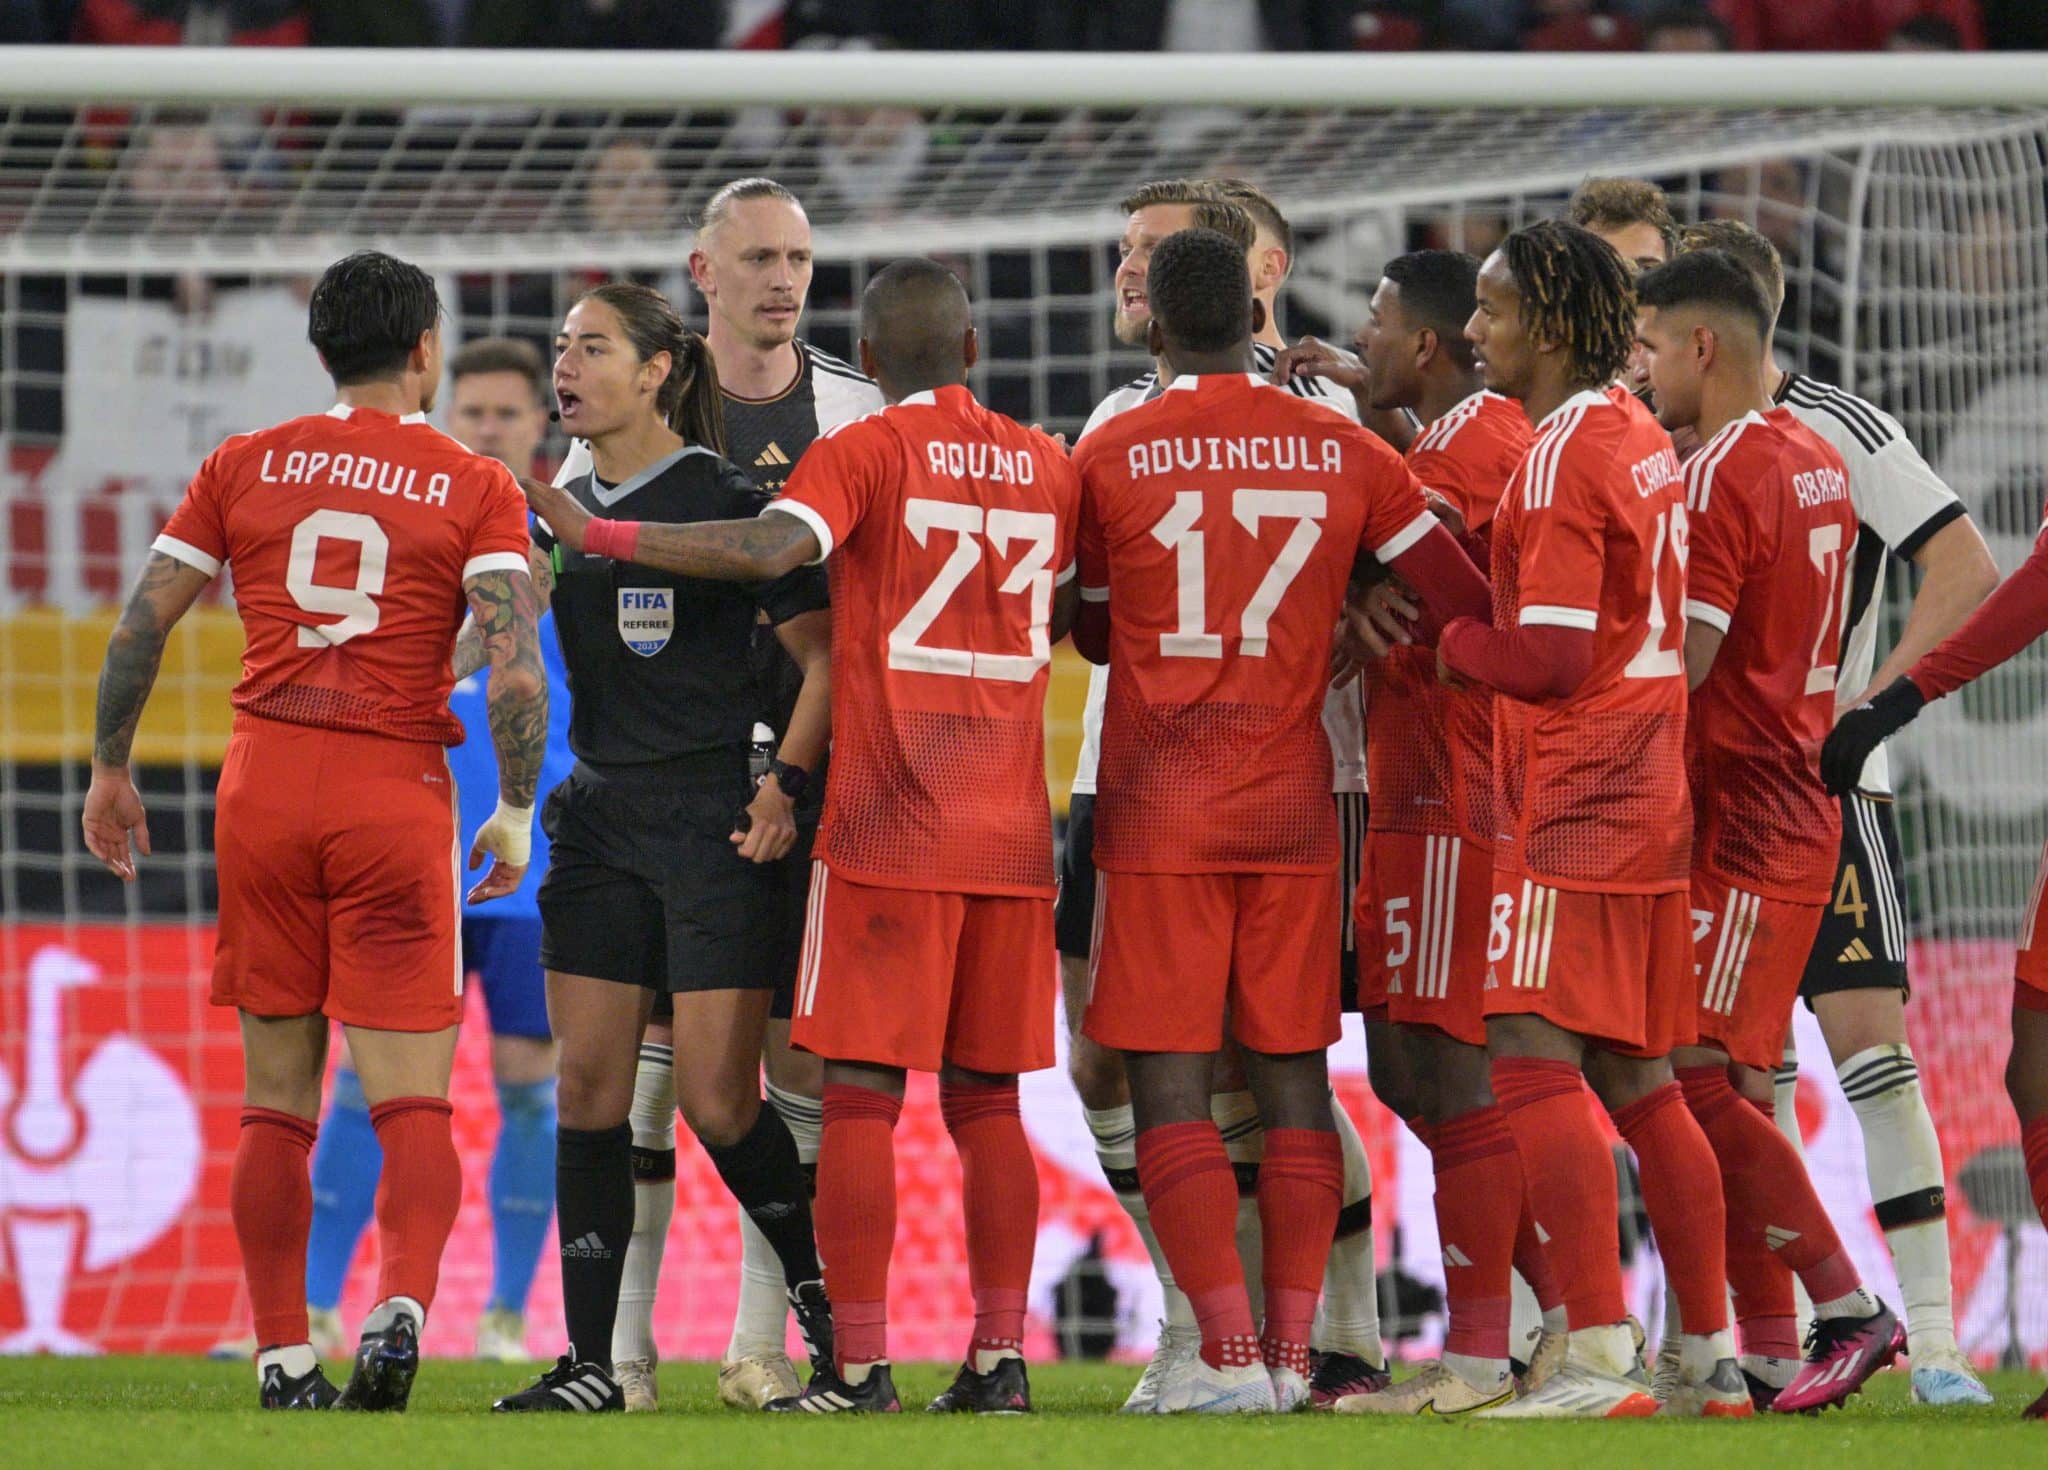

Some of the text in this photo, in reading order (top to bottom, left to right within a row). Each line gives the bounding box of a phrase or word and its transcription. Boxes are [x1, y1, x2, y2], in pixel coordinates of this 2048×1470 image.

[260, 450, 451, 507] LAPADULA
[927, 441, 1034, 485] AQUINO
[1128, 437, 1342, 479] ADVINCULA
[1793, 467, 1847, 509] ABRAM
[286, 508, 390, 648] 9
[888, 497, 1056, 682] 23
[1150, 488, 1327, 659] 17
[622, 592, 668, 609] FIFA
[623, 620, 669, 630] REFEREE
[637, 642, 658, 650] 2023
[1834, 864, 1868, 929] 4
[1385, 896, 1412, 968] 5
[1487, 893, 1514, 962] 8
[561, 1246, 612, 1259] adidas
